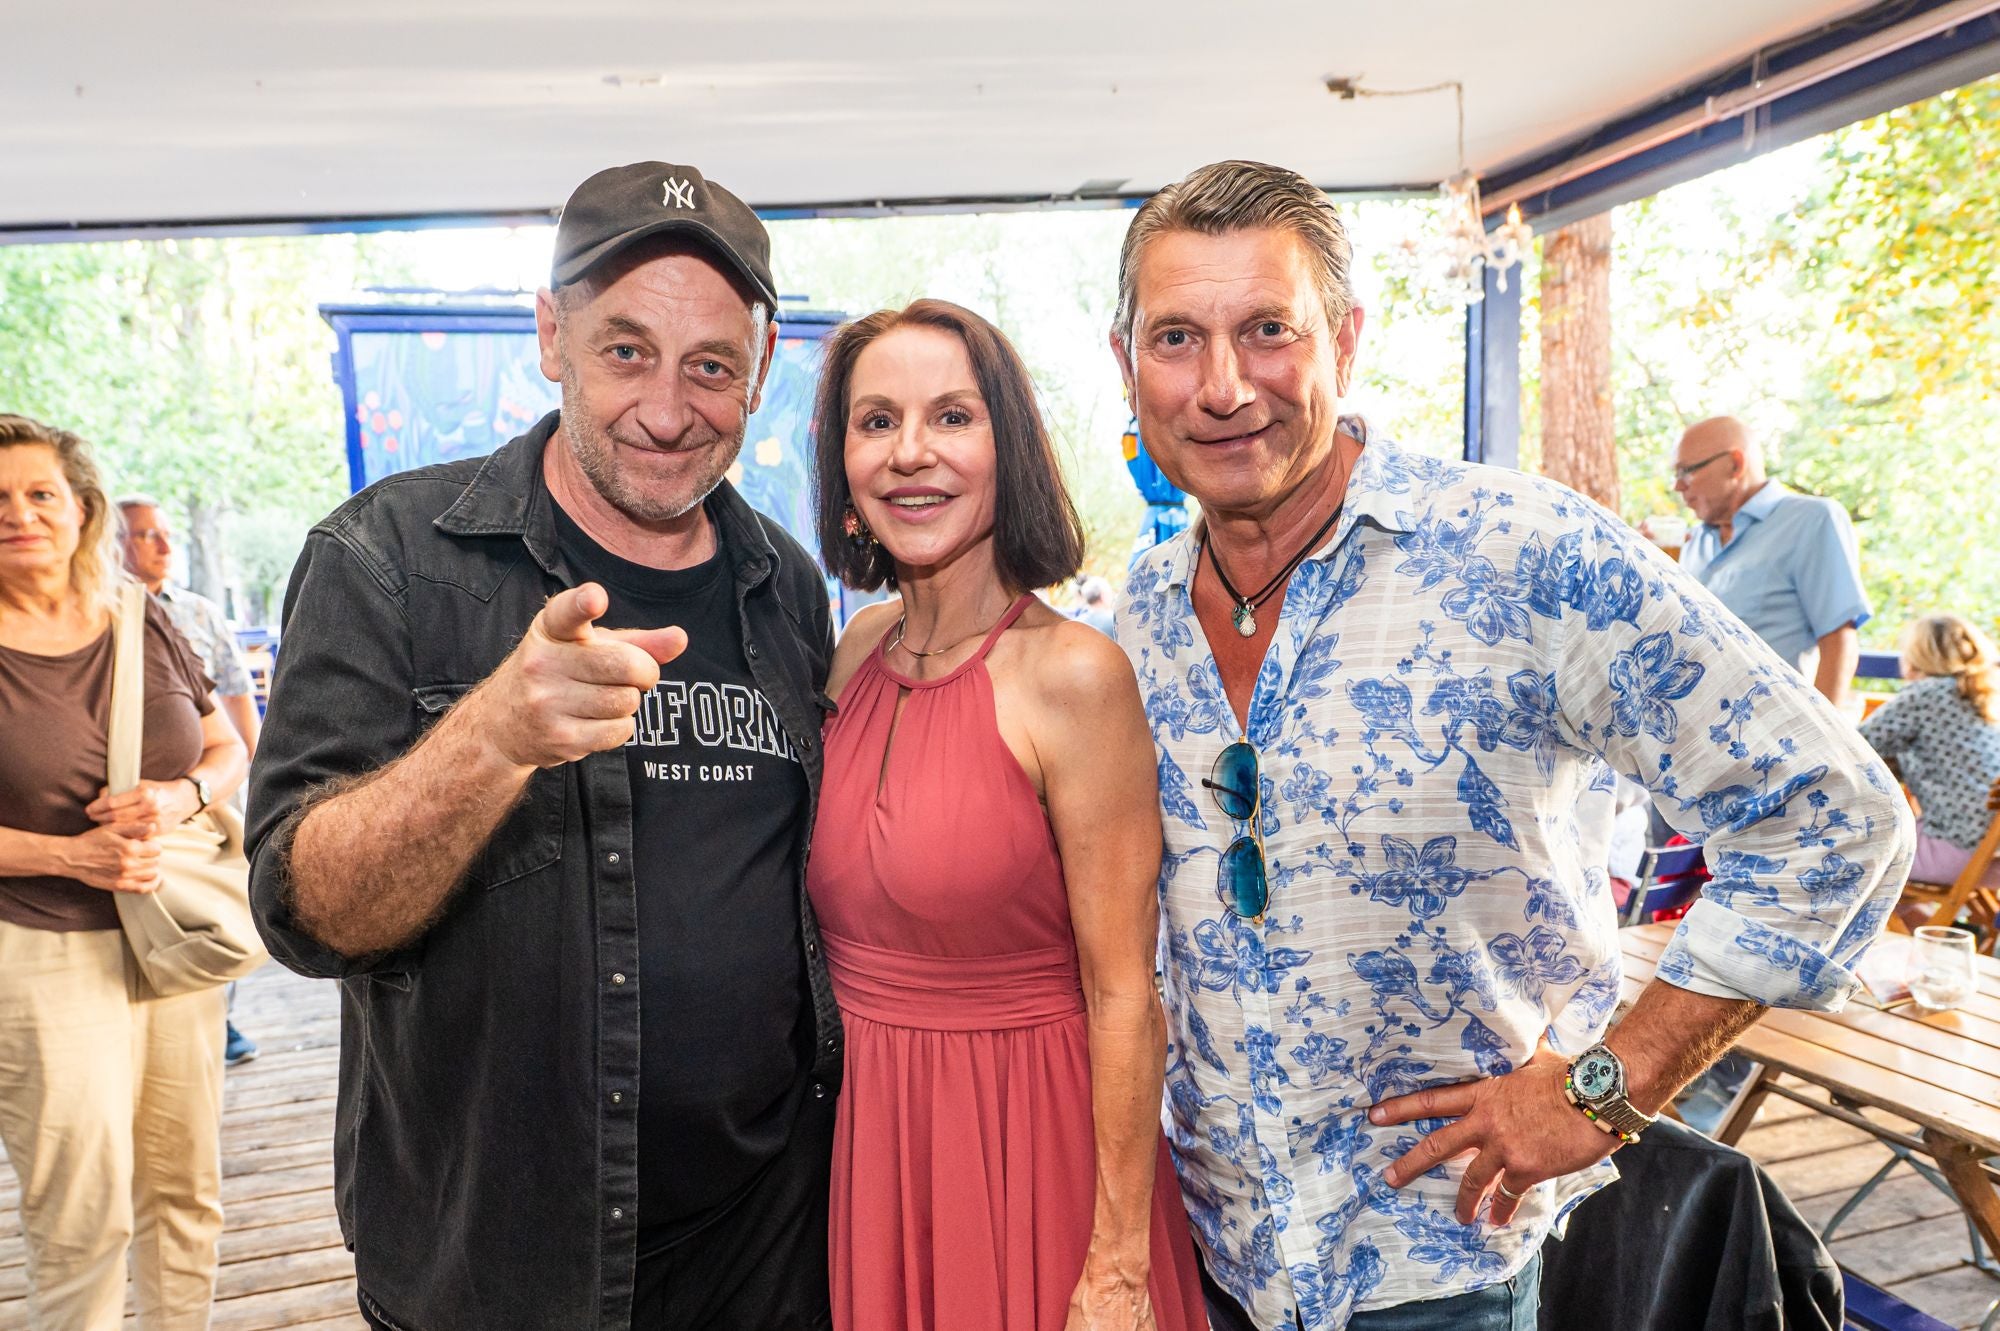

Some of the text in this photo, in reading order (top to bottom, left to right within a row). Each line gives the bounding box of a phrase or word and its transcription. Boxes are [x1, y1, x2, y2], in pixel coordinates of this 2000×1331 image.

[662, 176, 696, 210] NY
[643, 760, 754, 782] WEST COAST
